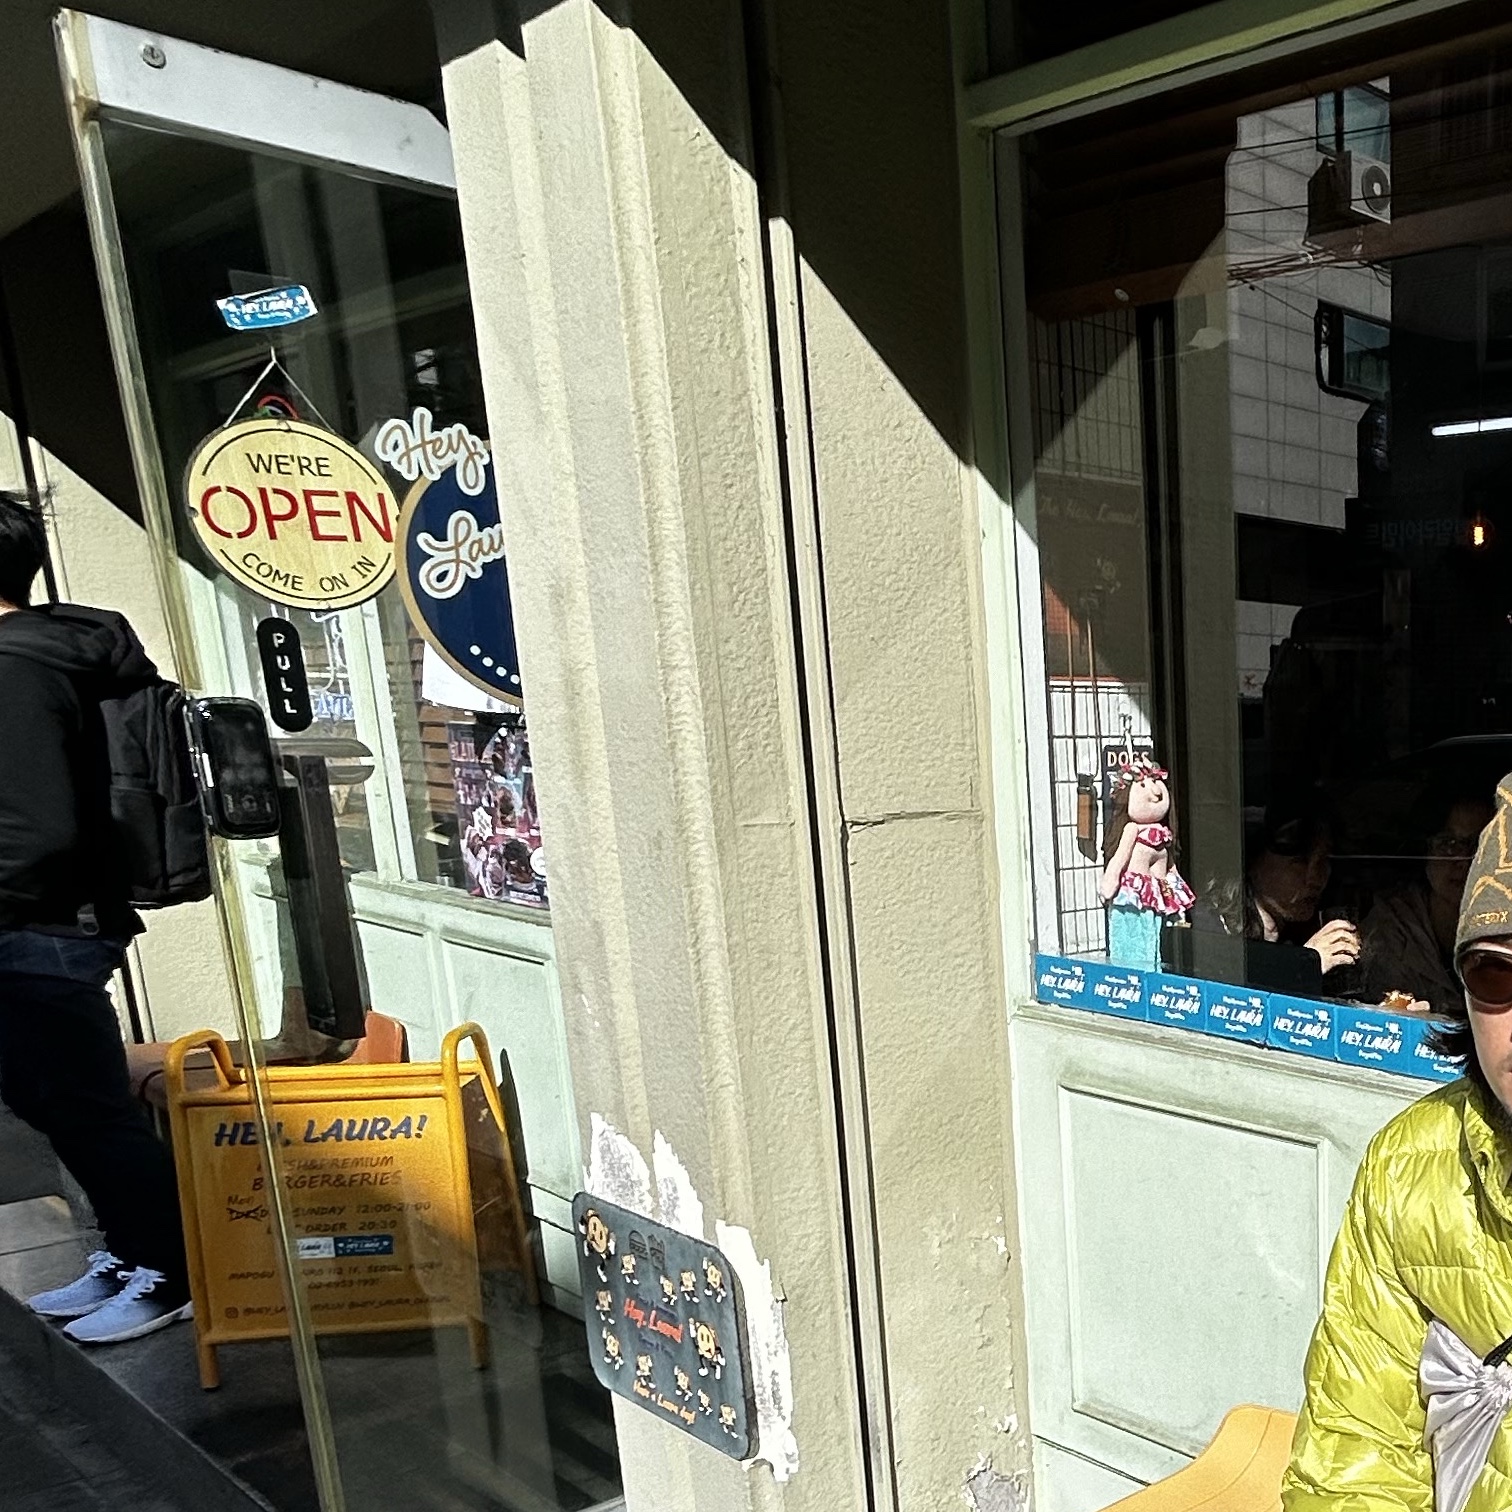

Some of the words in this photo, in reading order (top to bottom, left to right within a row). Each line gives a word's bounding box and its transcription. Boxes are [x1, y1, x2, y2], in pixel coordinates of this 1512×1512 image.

[246, 452, 332, 477] WE'RE
[200, 485, 393, 544] OPEN
[423, 515, 505, 593] Lau
[241, 552, 304, 593] COME
[319, 573, 350, 593] ON
[355, 555, 377, 580] IN
[272, 632, 298, 715] PULL
[214, 1122, 293, 1147] HE.
[303, 1115, 428, 1144] LAURA!
[251, 1169, 402, 1191] BRGER&FRIES
[256, 1156, 394, 1172] SH&PREMIUM
